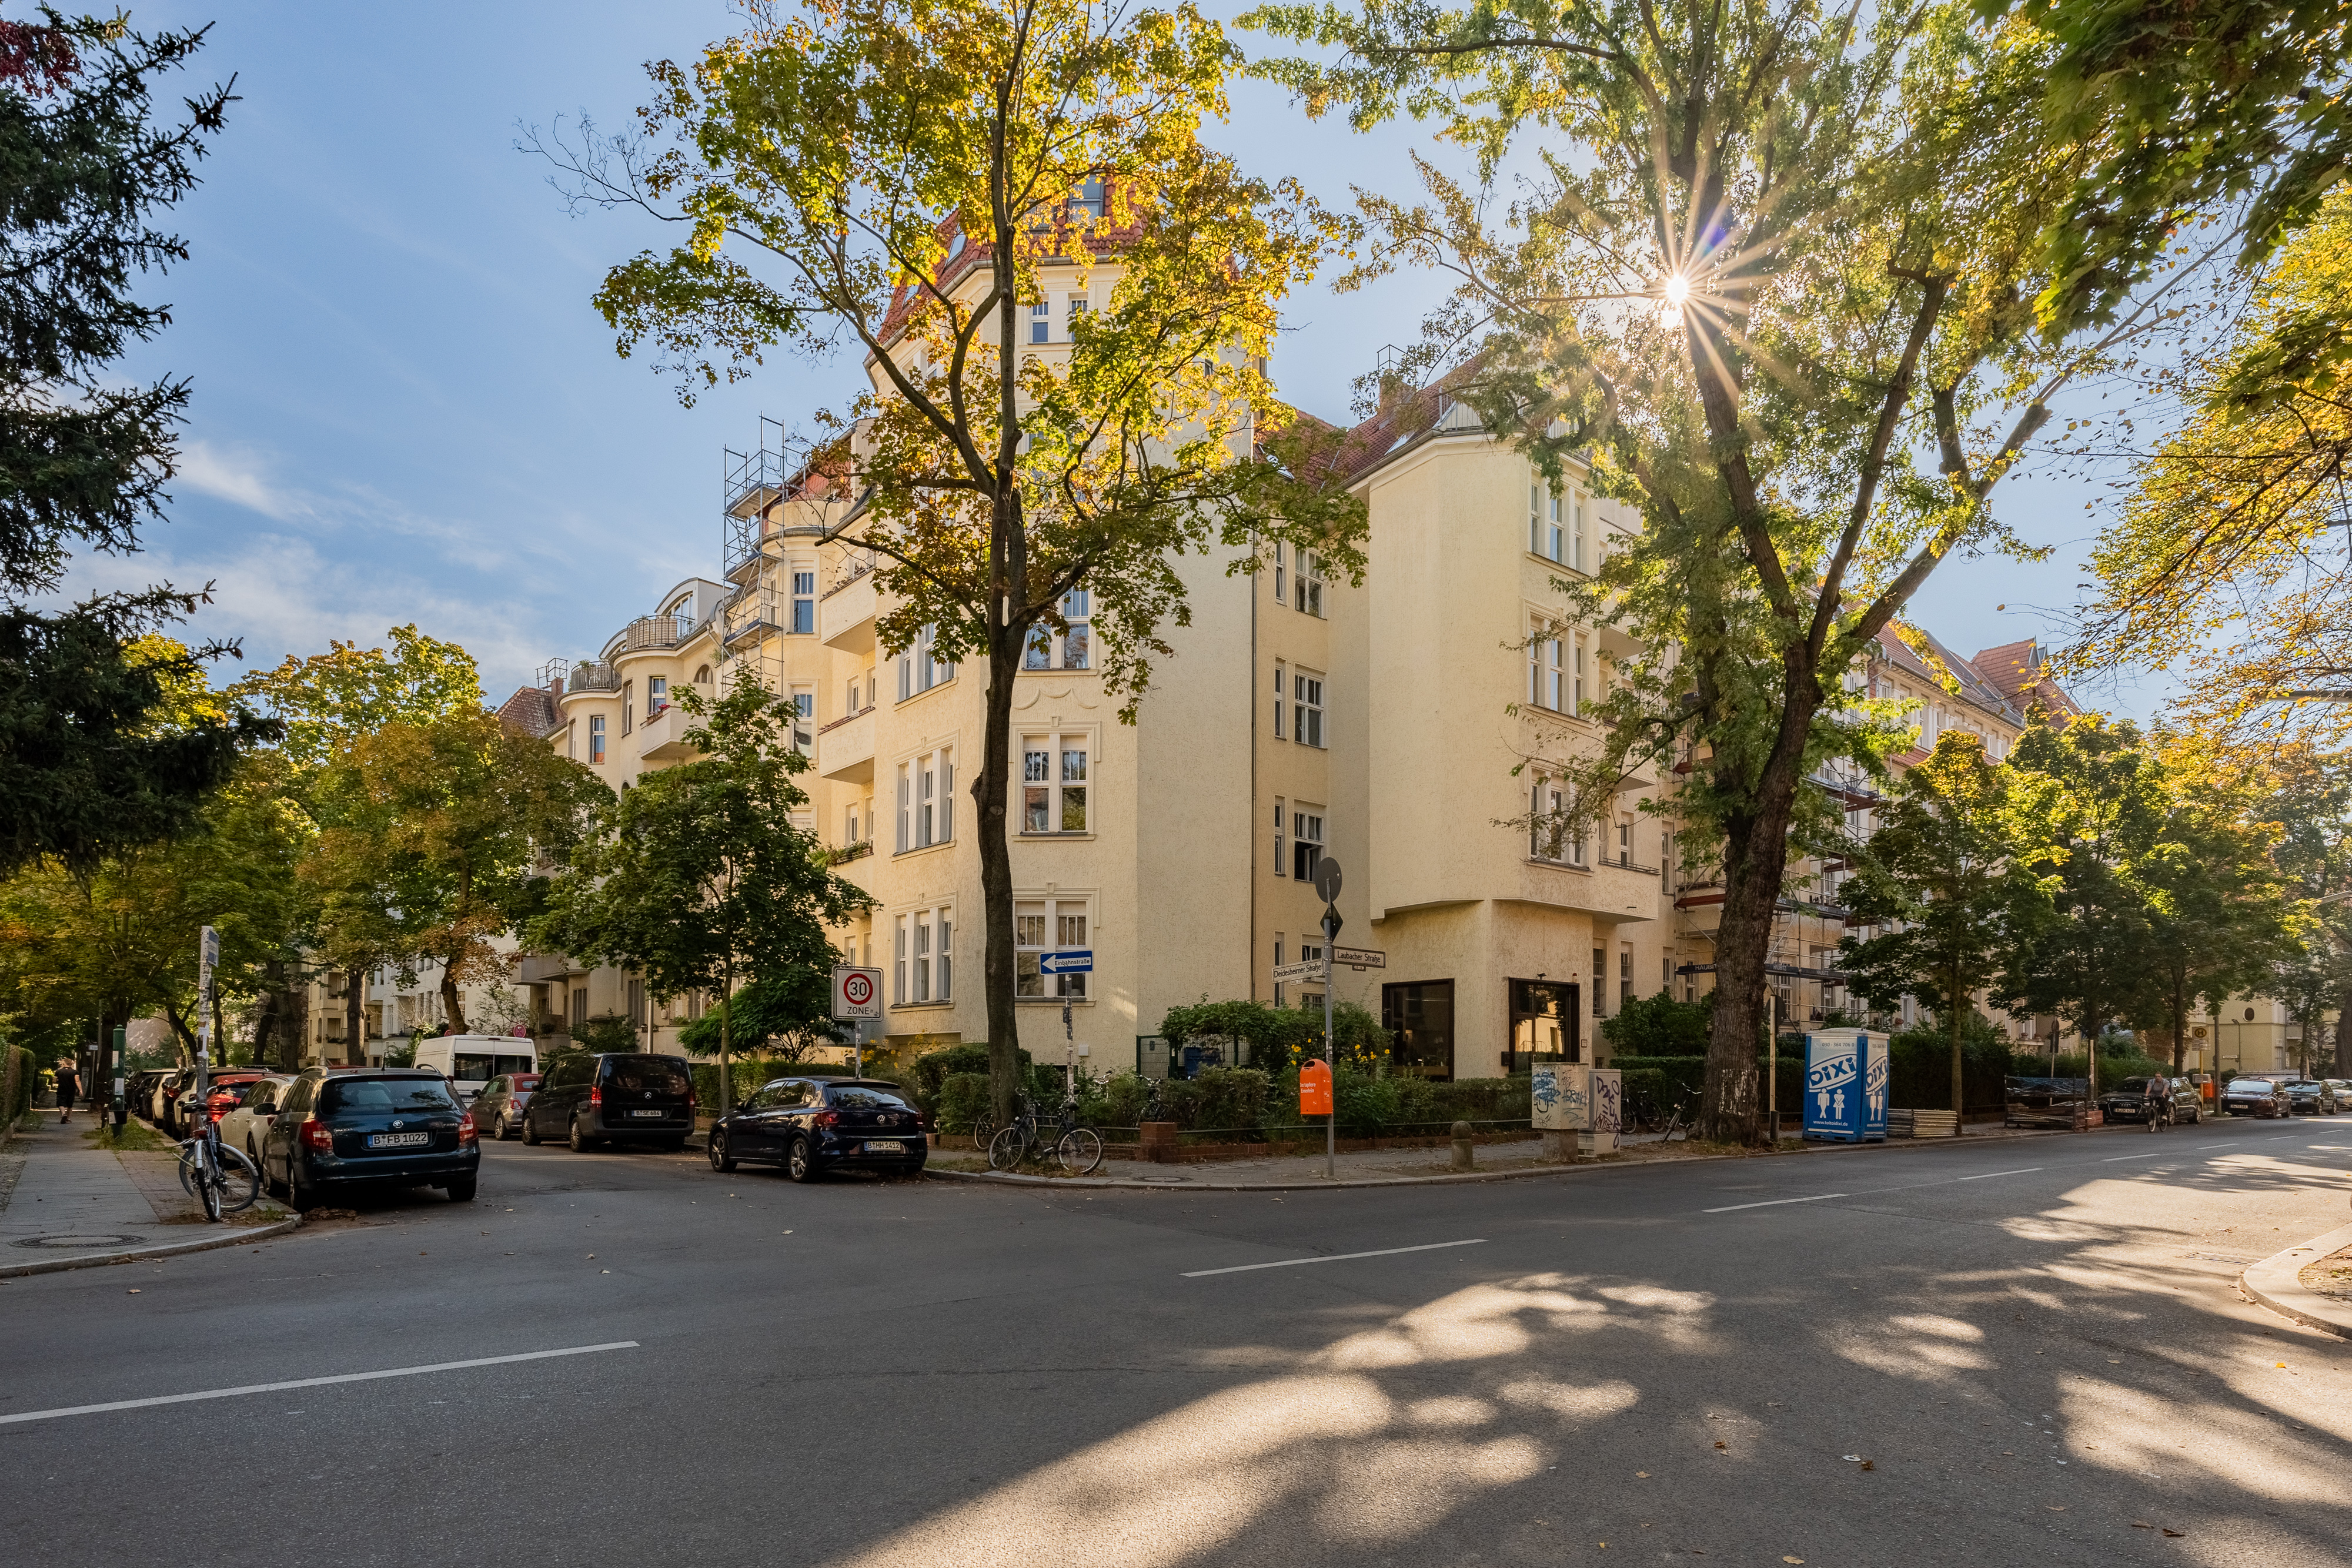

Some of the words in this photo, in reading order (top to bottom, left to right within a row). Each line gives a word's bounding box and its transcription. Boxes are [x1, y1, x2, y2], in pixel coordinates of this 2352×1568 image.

[1338, 950, 1362, 961] Laubacher
[1365, 953, 1380, 964] Straße
[1274, 967, 1305, 978] Deidesheimer
[1307, 963, 1321, 972] Straße
[850, 982, 867, 996] 30
[374, 1136, 380, 1144] B
[387, 1135, 400, 1144] FB
[403, 1134, 427, 1142] 1022
